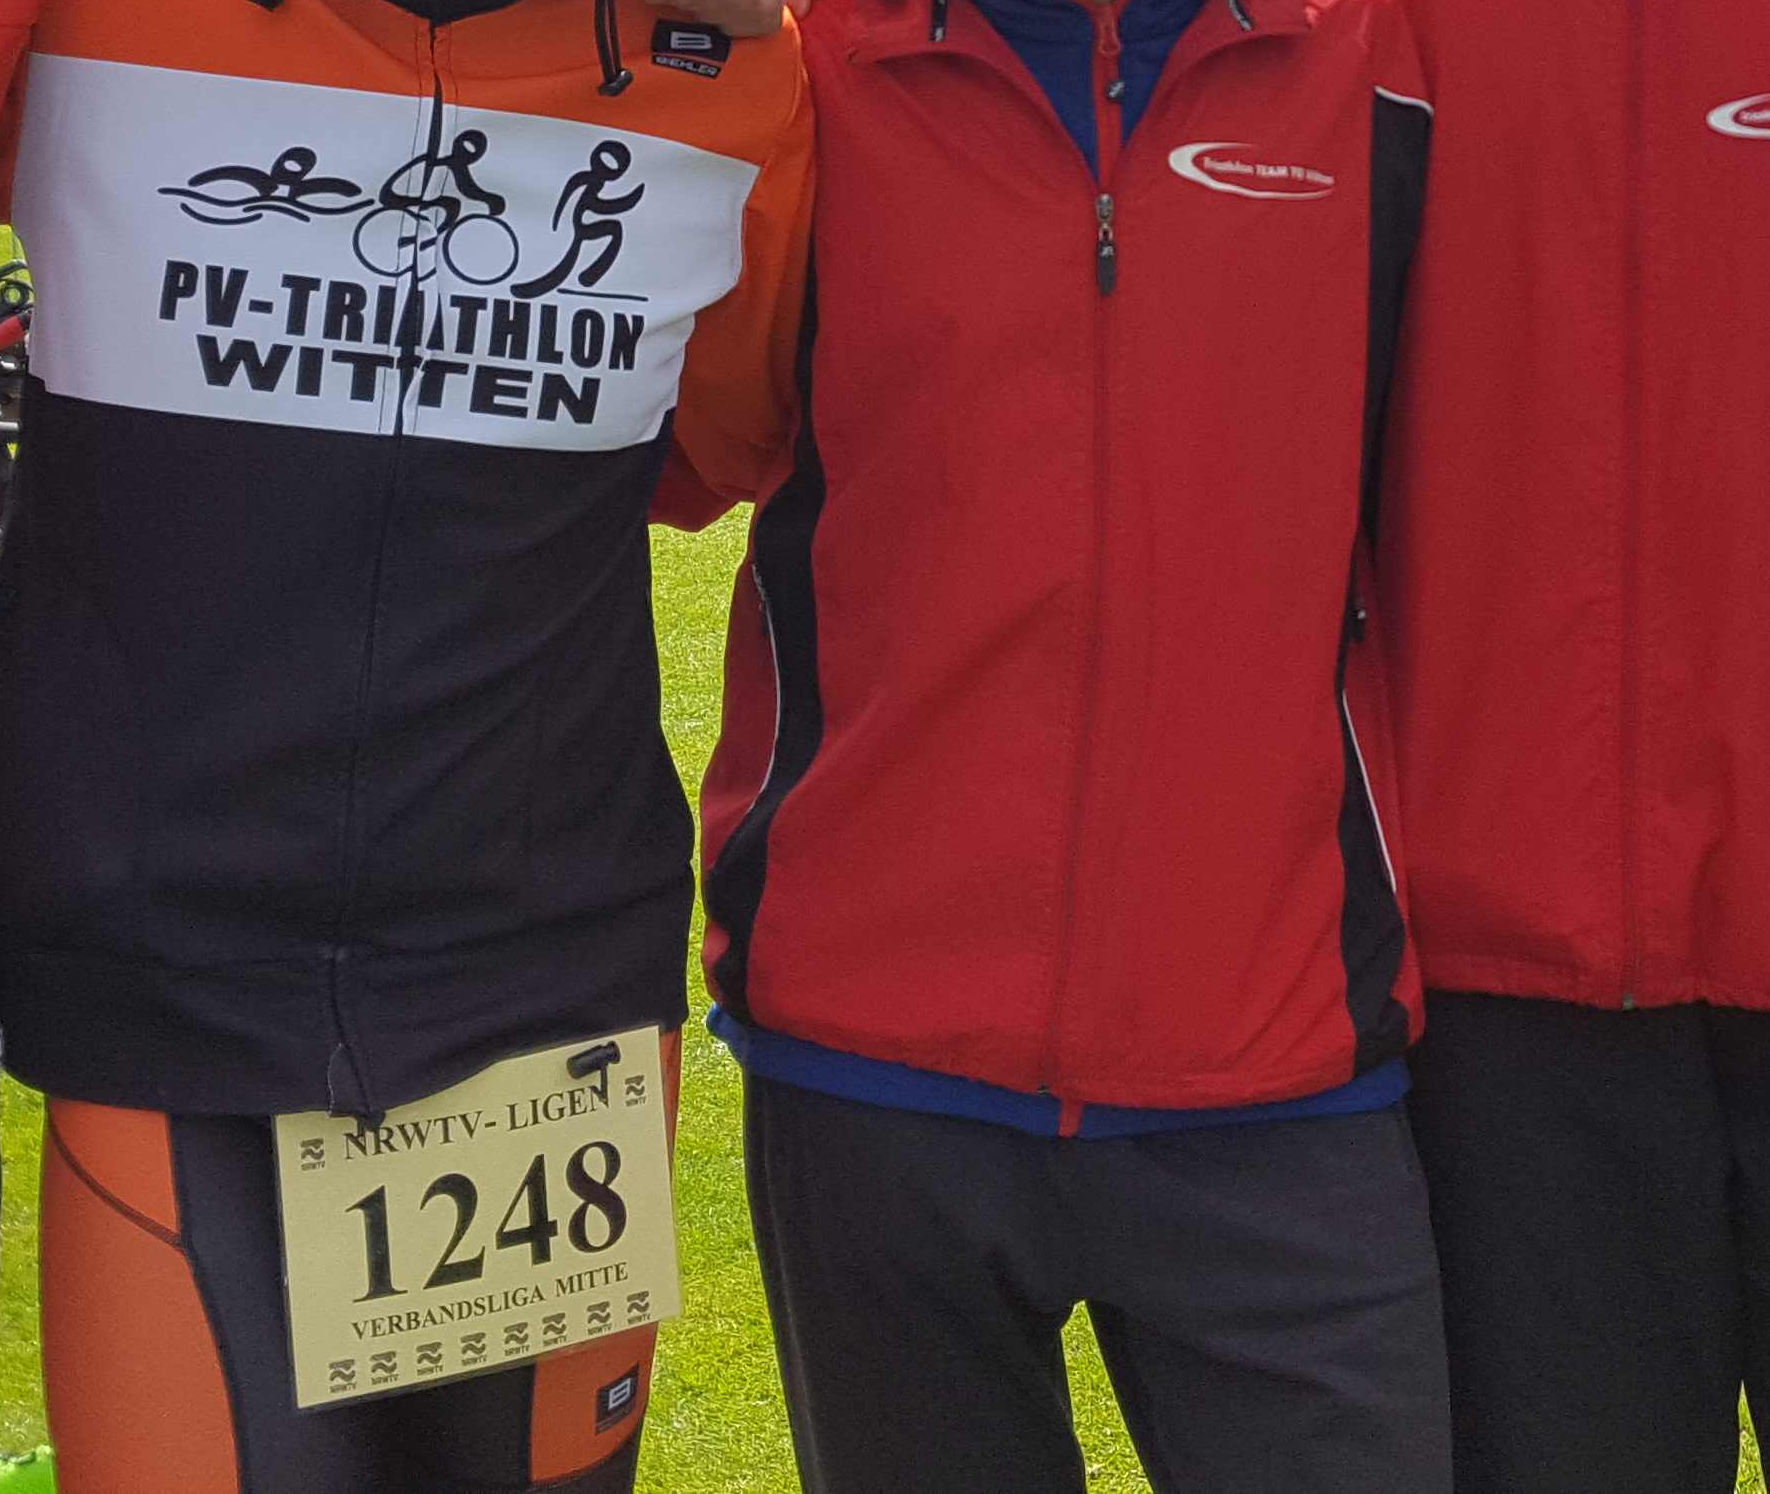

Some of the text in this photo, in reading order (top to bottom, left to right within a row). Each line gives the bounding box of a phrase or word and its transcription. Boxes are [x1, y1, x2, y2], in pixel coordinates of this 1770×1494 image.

[159, 260, 645, 371] PV-TRIATHLON
[196, 334, 600, 425] WITTEN
[506, 1082, 610, 1131] LIGEN
[345, 1141, 627, 1303] 1248
[351, 1261, 628, 1340] VERBANDSLIGA MITTE
